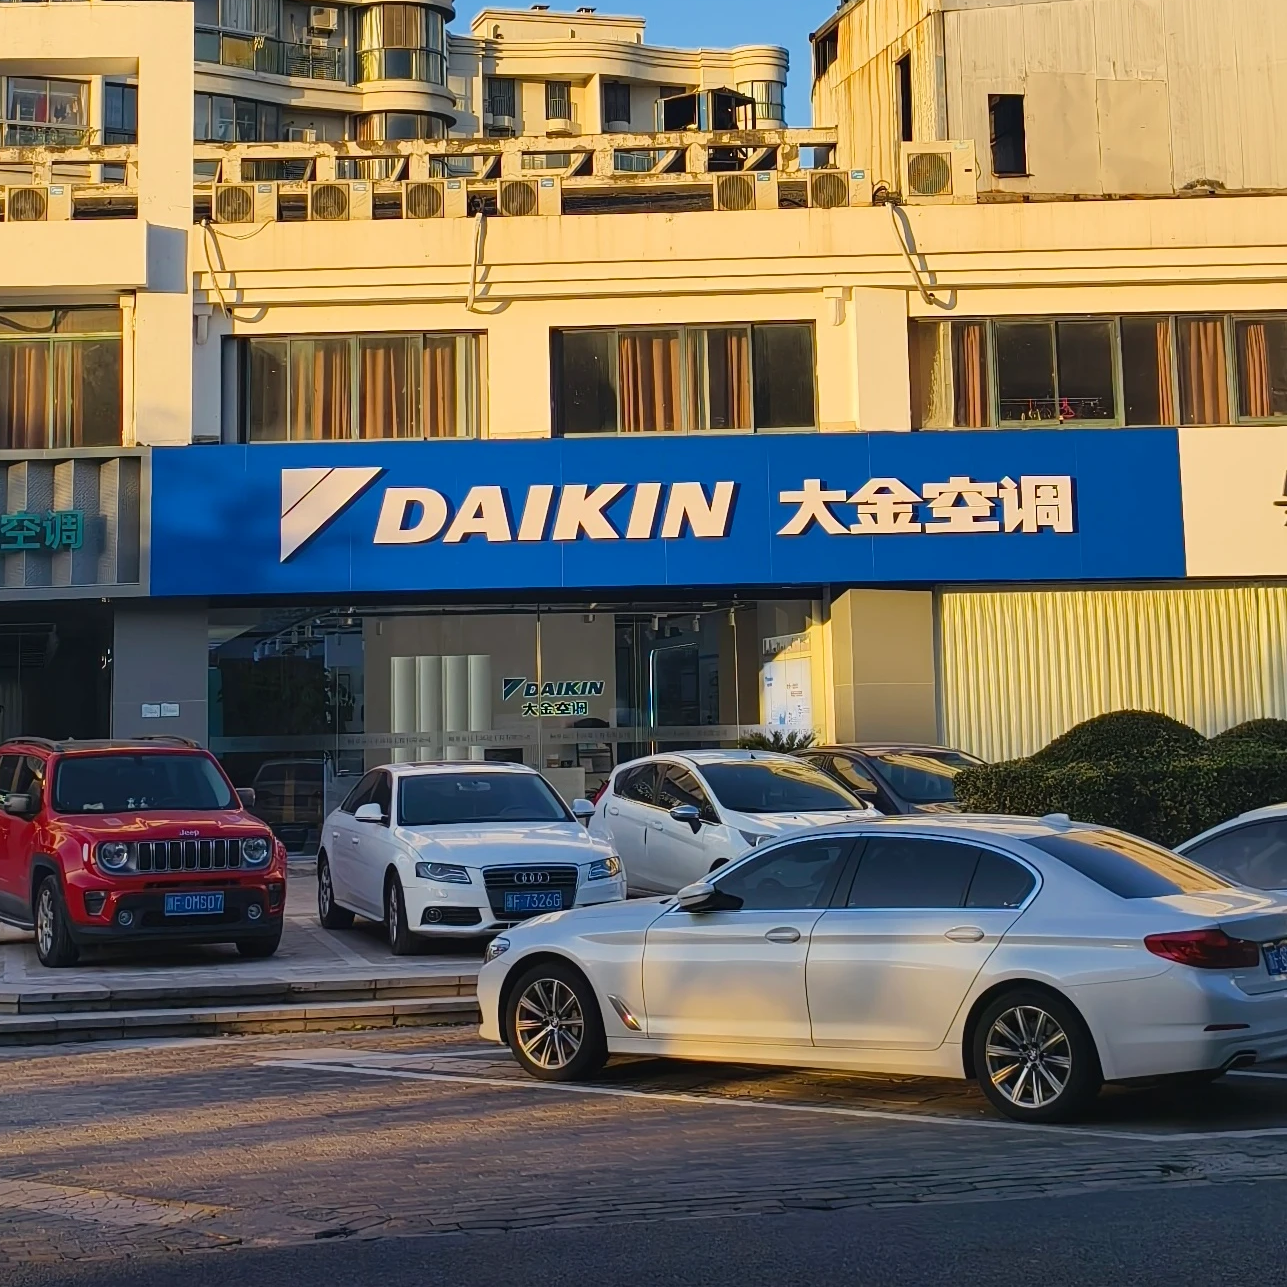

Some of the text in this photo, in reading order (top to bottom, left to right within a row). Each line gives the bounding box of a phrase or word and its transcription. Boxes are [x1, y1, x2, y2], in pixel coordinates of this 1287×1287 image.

[372, 475, 1073, 544] DAIKIN 大金空调
[523, 680, 605, 698] DAIKIN
[522, 700, 588, 717] 大金空调
[179, 829, 200, 837] Jeep
